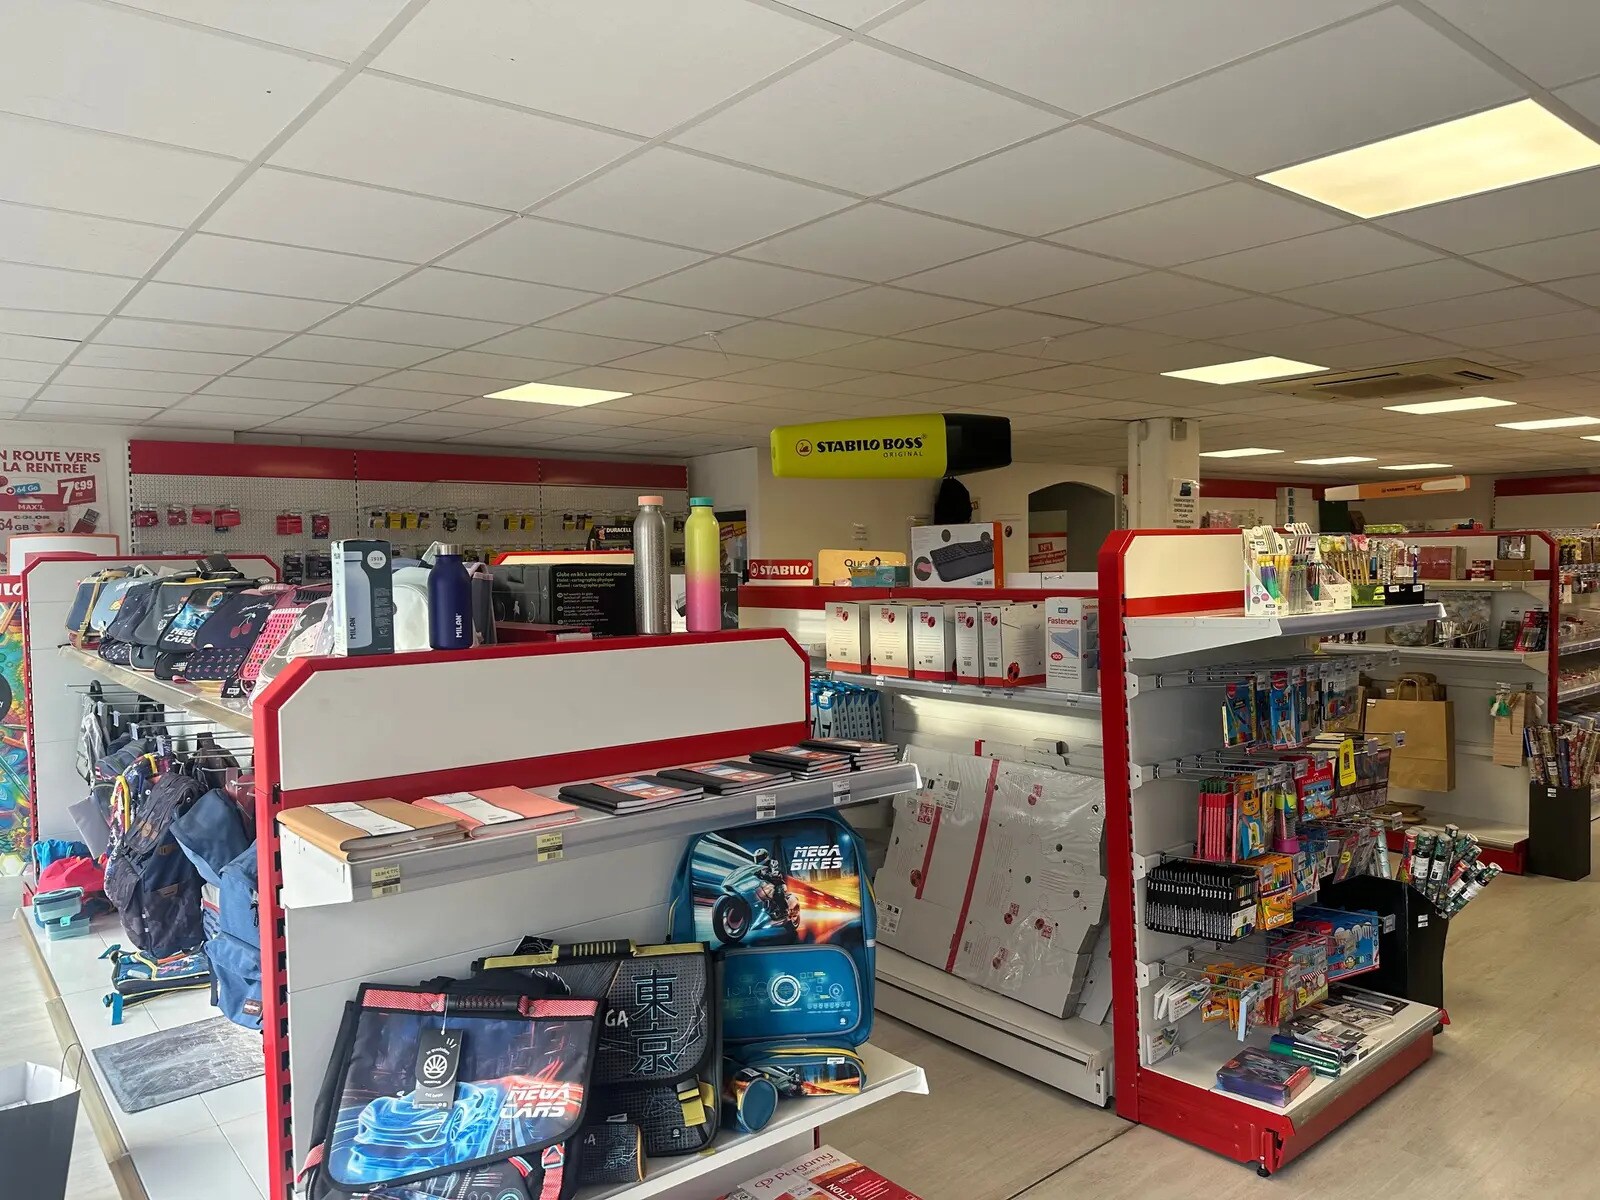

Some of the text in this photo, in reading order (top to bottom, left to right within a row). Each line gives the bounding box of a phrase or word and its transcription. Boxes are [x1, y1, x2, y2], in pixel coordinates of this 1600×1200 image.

[816, 439, 880, 453] STABILO
[13, 450, 60, 462] ROUTE
[65, 452, 100, 463] VERS
[883, 450, 923, 458] ORIGINAL
[3, 461, 87, 474] LA RENTRÉE
[27, 484, 38, 492] Go
[1047, 616, 1079, 626] Fasteneur
[170, 627, 197, 637] MEGA
[164, 634, 195, 645] CARS
[793, 844, 841, 858] MEGA
[790, 857, 843, 871] BIKES
[630, 969, 679, 1075] 東京
[507, 1082, 571, 1102] MEGA
[500, 1101, 568, 1118] CARS
